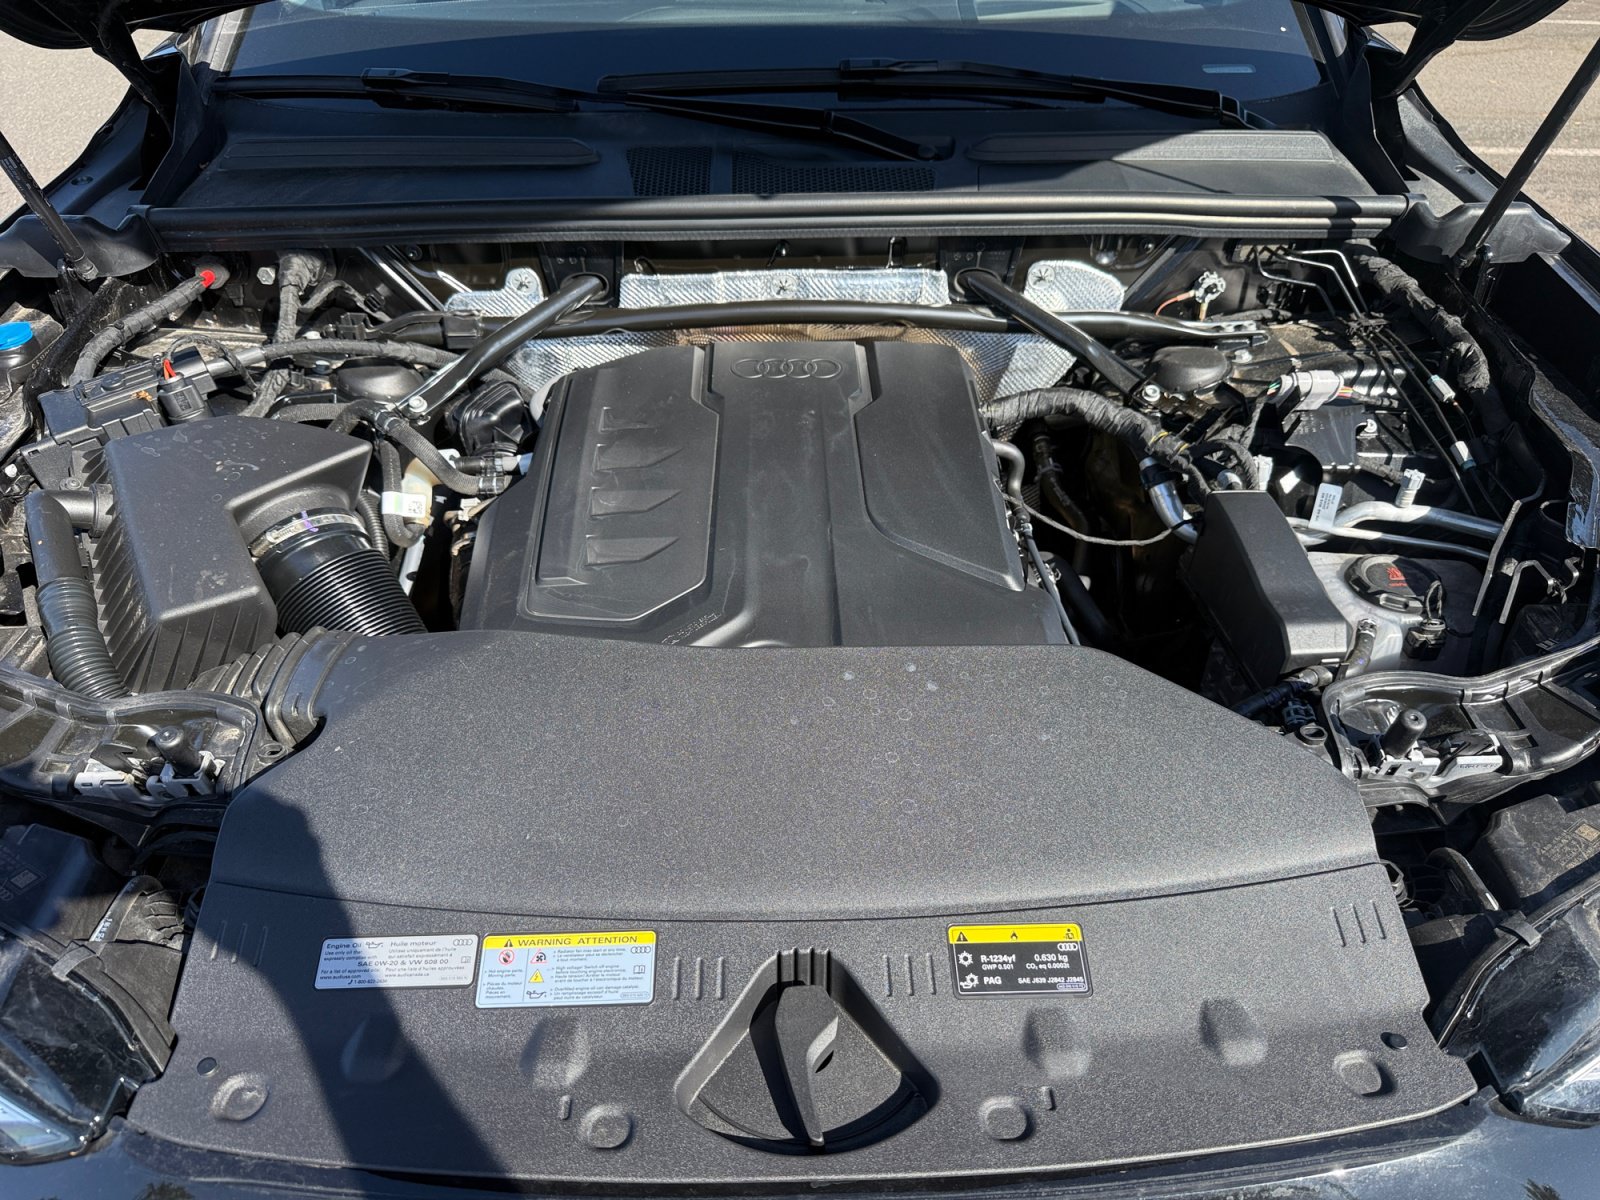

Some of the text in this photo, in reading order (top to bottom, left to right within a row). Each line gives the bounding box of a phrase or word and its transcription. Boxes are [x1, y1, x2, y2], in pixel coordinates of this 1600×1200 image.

[518, 936, 638, 946] WARNING ATTENTION
[980, 954, 1016, 963] R-1234yf
[1058, 953, 1068, 962] kg
[983, 976, 1002, 984] PAG
